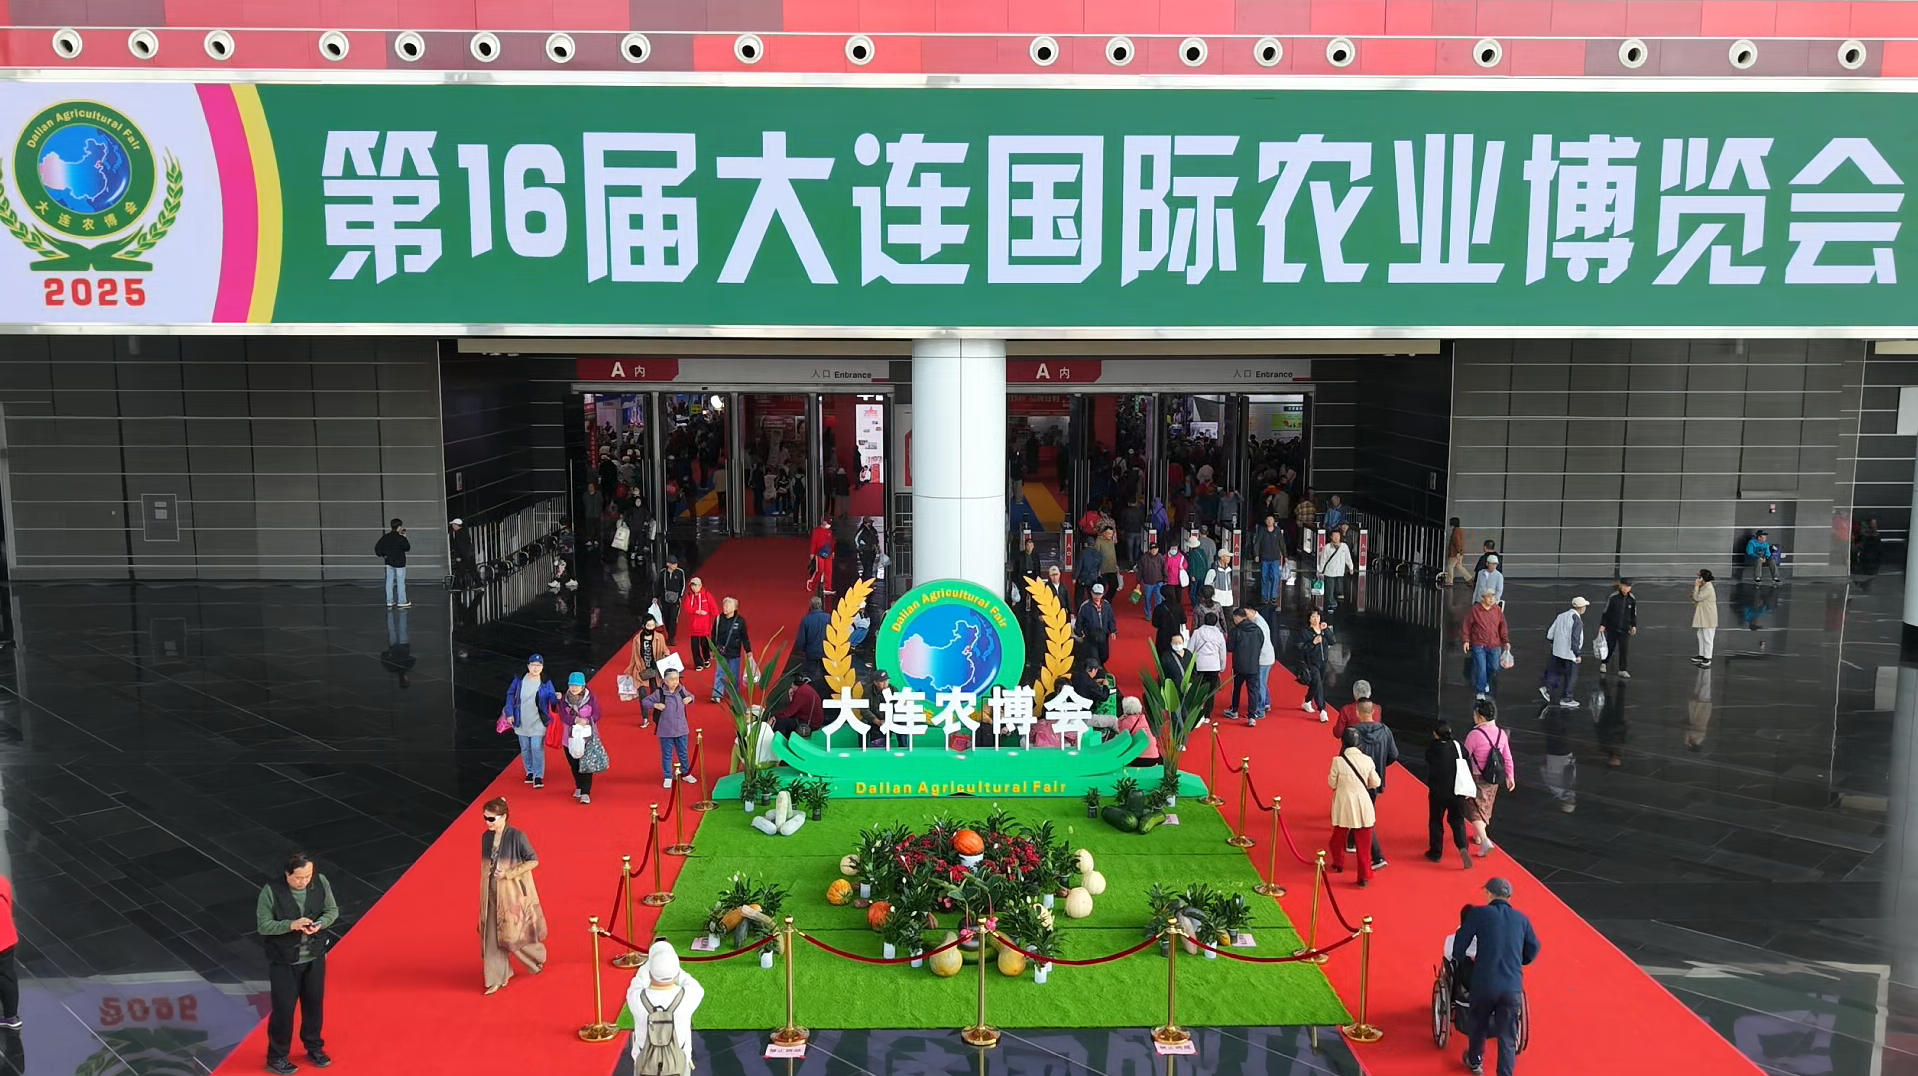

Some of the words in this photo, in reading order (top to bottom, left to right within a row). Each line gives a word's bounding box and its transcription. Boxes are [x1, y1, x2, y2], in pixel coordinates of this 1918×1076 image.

[27, 119, 54, 149] Dalian
[55, 108, 123, 131] Agricultural
[122, 128, 141, 151] Fair
[321, 130, 1905, 287] 第16届大连国际农业博览会
[44, 277, 146, 306] 2025
[610, 361, 626, 378] A
[634, 365, 646, 378] 内
[834, 371, 872, 379] Entrance
[1035, 362, 1050, 379] A
[1059, 366, 1070, 379] 内
[1255, 370, 1293, 378] Entrance
[891, 601, 921, 633] Dalian
[921, 588, 991, 608] Agricultural
[989, 605, 1008, 628] Fair
[822, 685, 1094, 736] 大连农博会
[855, 781, 912, 794] Dalian
[917, 780, 1028, 797] Agricultural
[1032, 780, 1067, 793] Fair
